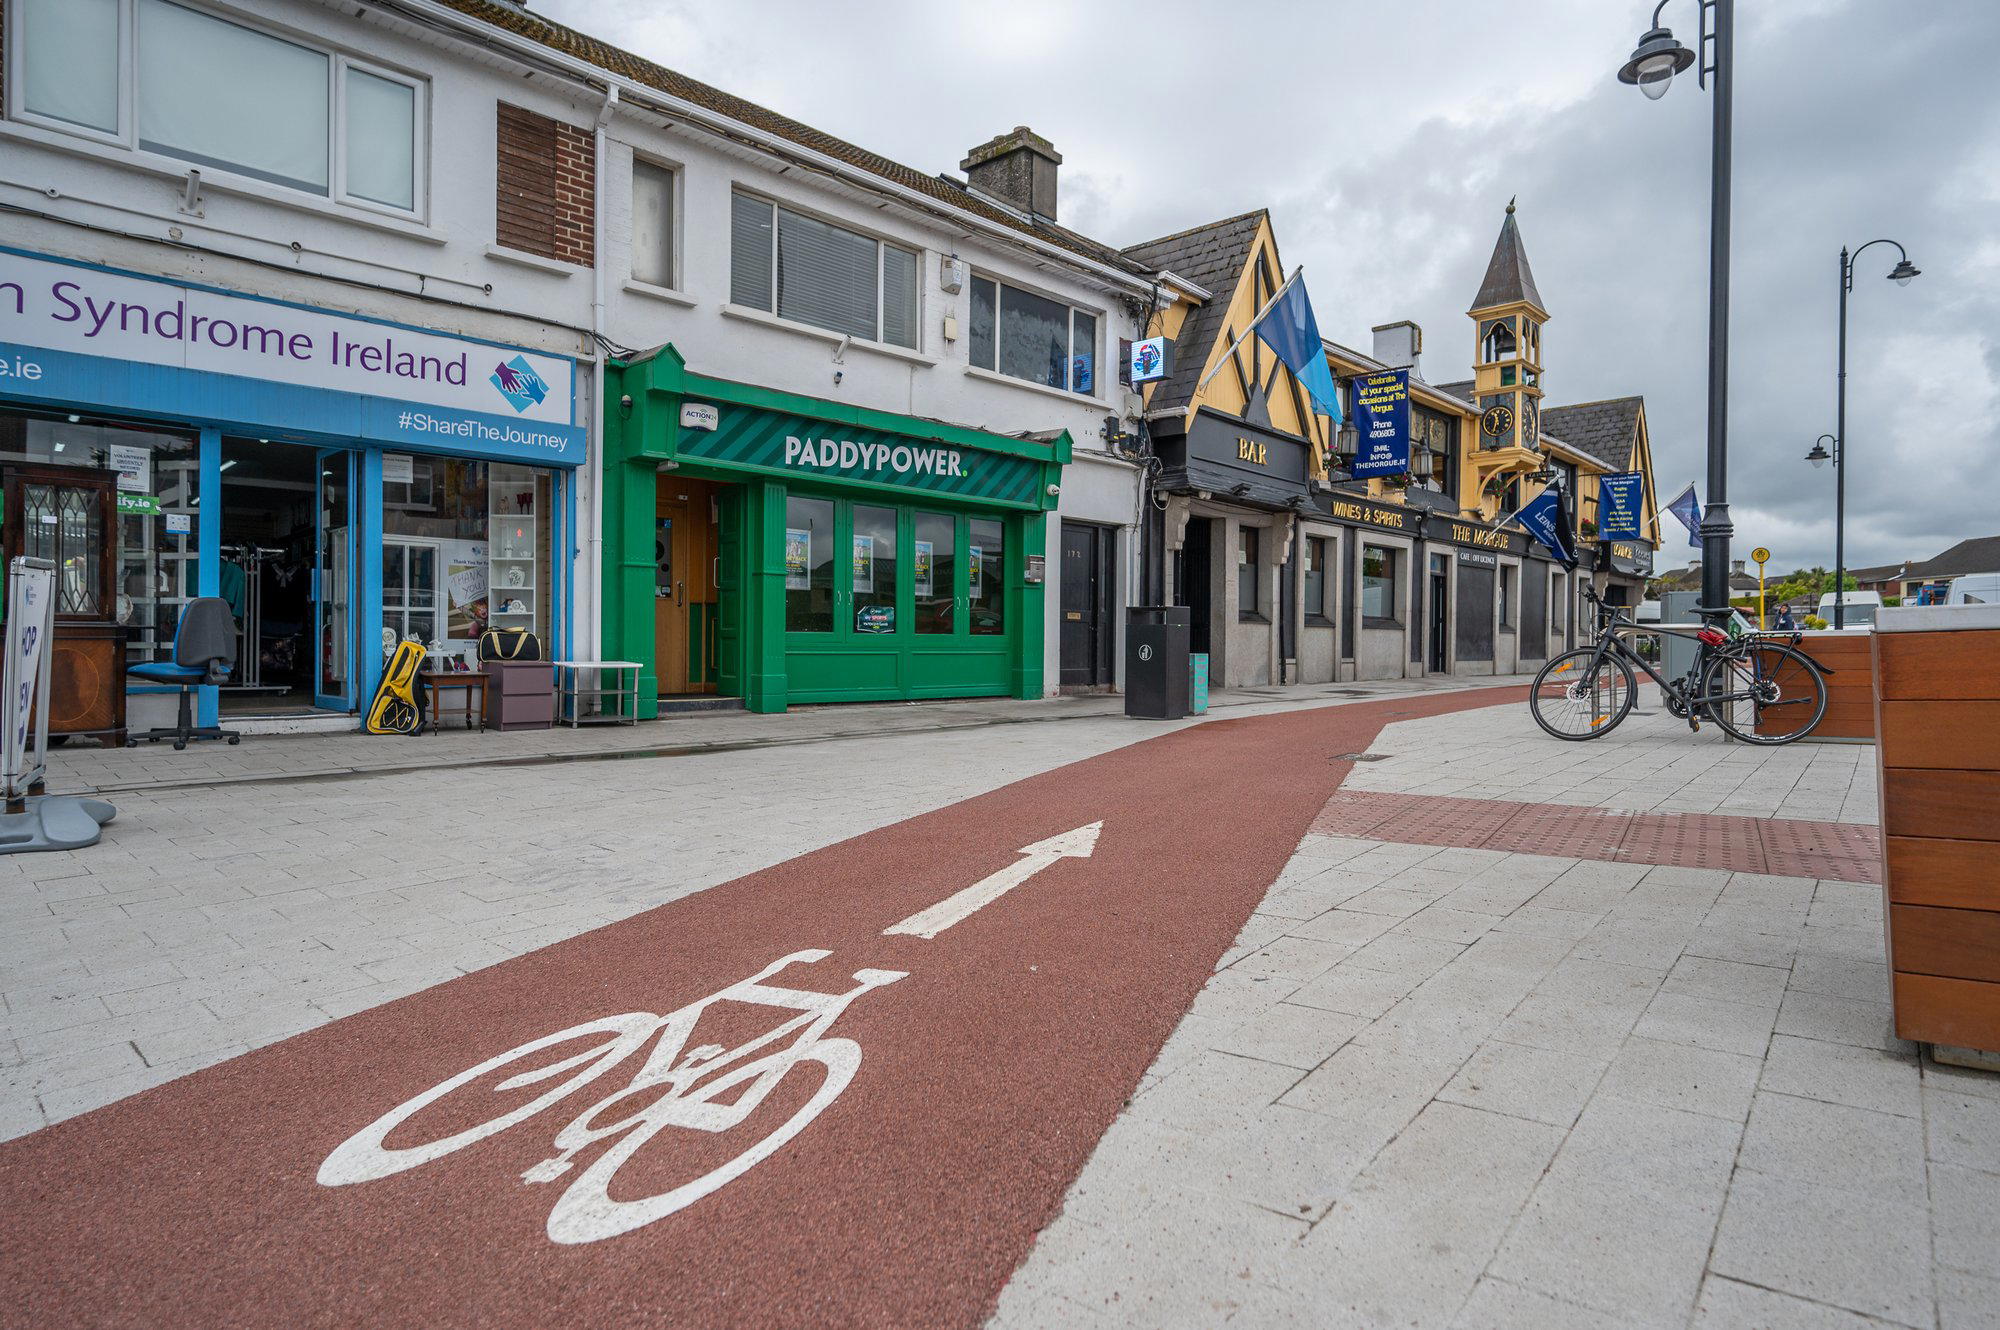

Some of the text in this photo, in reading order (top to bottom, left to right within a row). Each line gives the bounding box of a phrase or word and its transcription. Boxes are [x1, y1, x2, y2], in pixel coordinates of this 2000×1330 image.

[50, 281, 314, 360] Syndrome
[331, 331, 468, 386] Ireland
[1367, 375, 1397, 386] Celebrate
[1369, 386, 1383, 397] your
[1383, 382, 1404, 394] special
[1358, 394, 1388, 405] occasions
[1395, 391, 1406, 401] The
[398, 410, 568, 453] #ShareTheJourney
[1373, 420, 1392, 429] Phone
[1239, 437, 1267, 465] BAR
[1370, 452, 1393, 461] INFO@
[1355, 458, 1406, 470] THEMORGUE.IE
[1333, 501, 1403, 528] WINES & SPIRITS
[1452, 523, 1471, 542] THE
[1067, 549, 1081, 558] 172
[1459, 552, 1470, 561] CAFE
[450, 569, 483, 587] THANK
